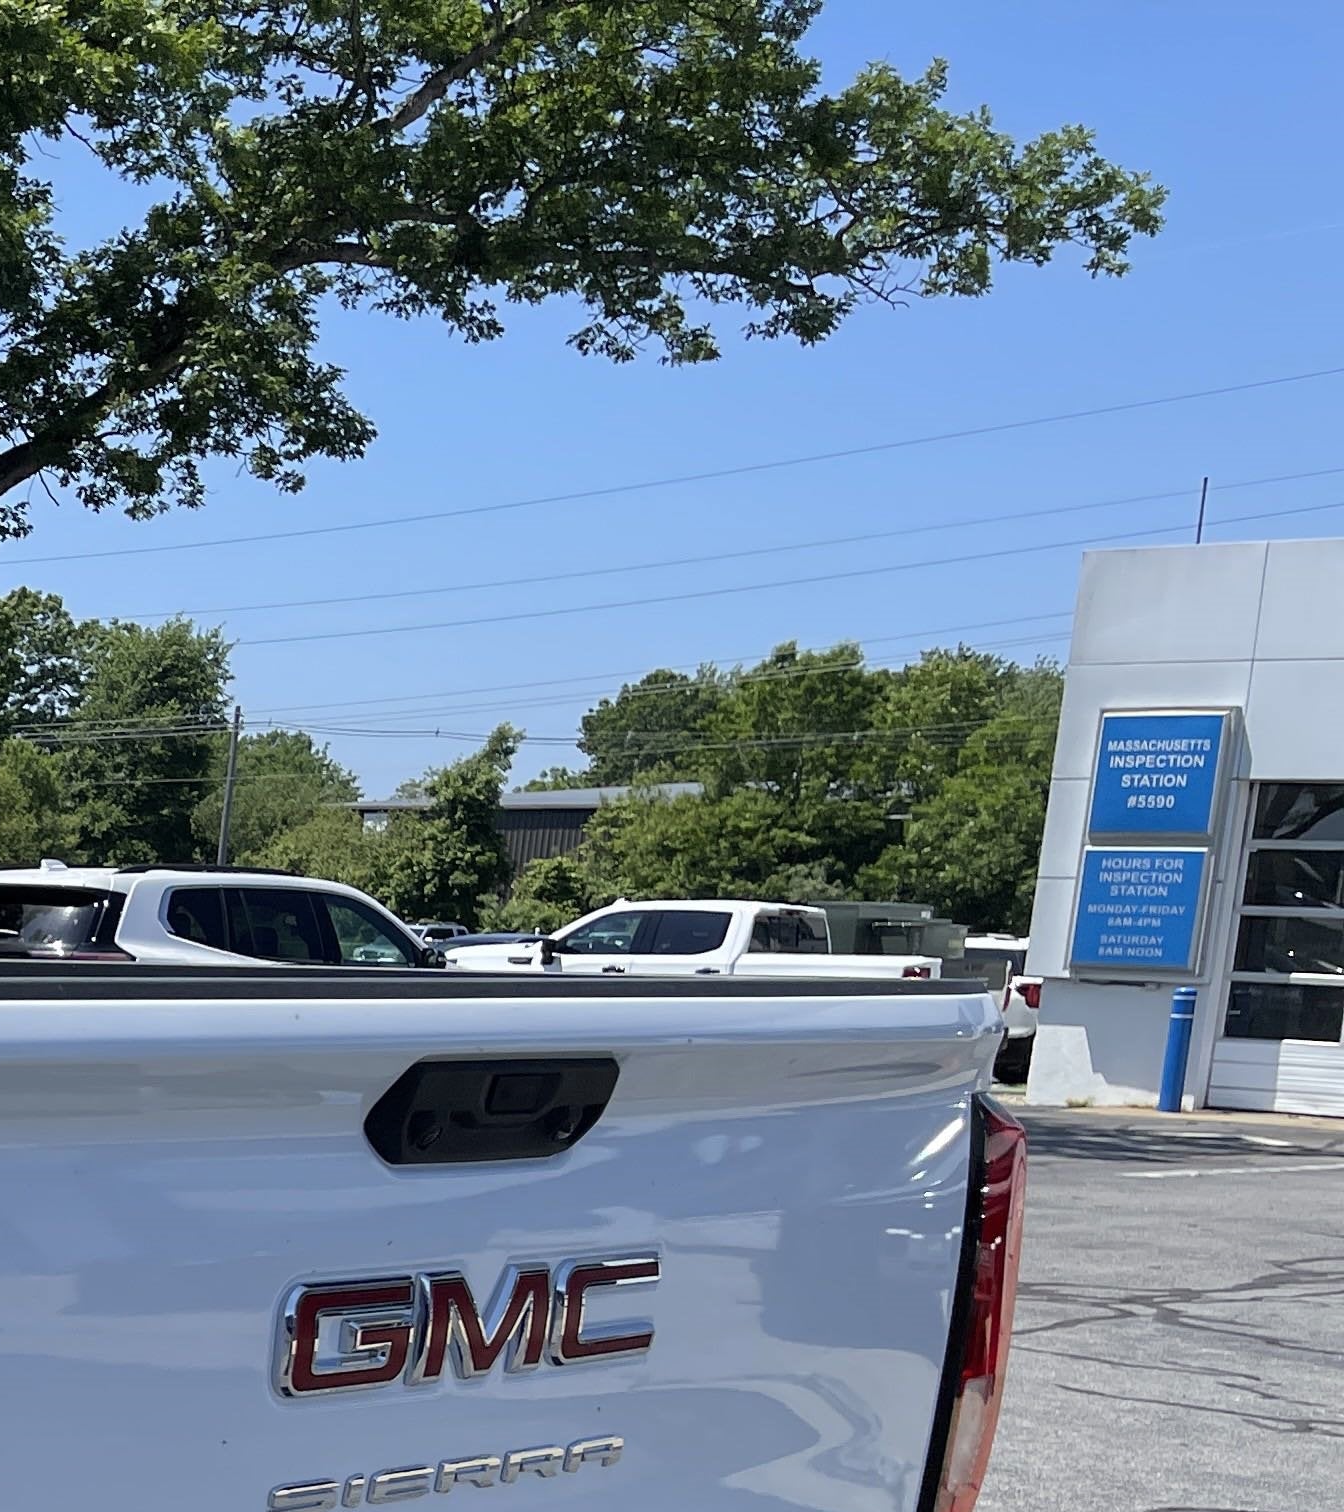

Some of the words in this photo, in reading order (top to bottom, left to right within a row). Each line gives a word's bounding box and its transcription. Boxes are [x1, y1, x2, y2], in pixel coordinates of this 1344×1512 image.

[1107, 739, 1211, 752] MASSACHUSETTS
[1109, 754, 1205, 768] INSPECTION
[1120, 773, 1188, 788] STATION
[1101, 858, 1151, 870] HOURS
[1155, 858, 1185, 870] FOR
[1099, 871, 1183, 883] INSPECTION
[1110, 885, 1169, 897] STATION
[1087, 904, 1186, 915] MONDAY-FRIDAY
[1099, 934, 1164, 945] SATURDAY
[270, 1251, 663, 1397] GMC
